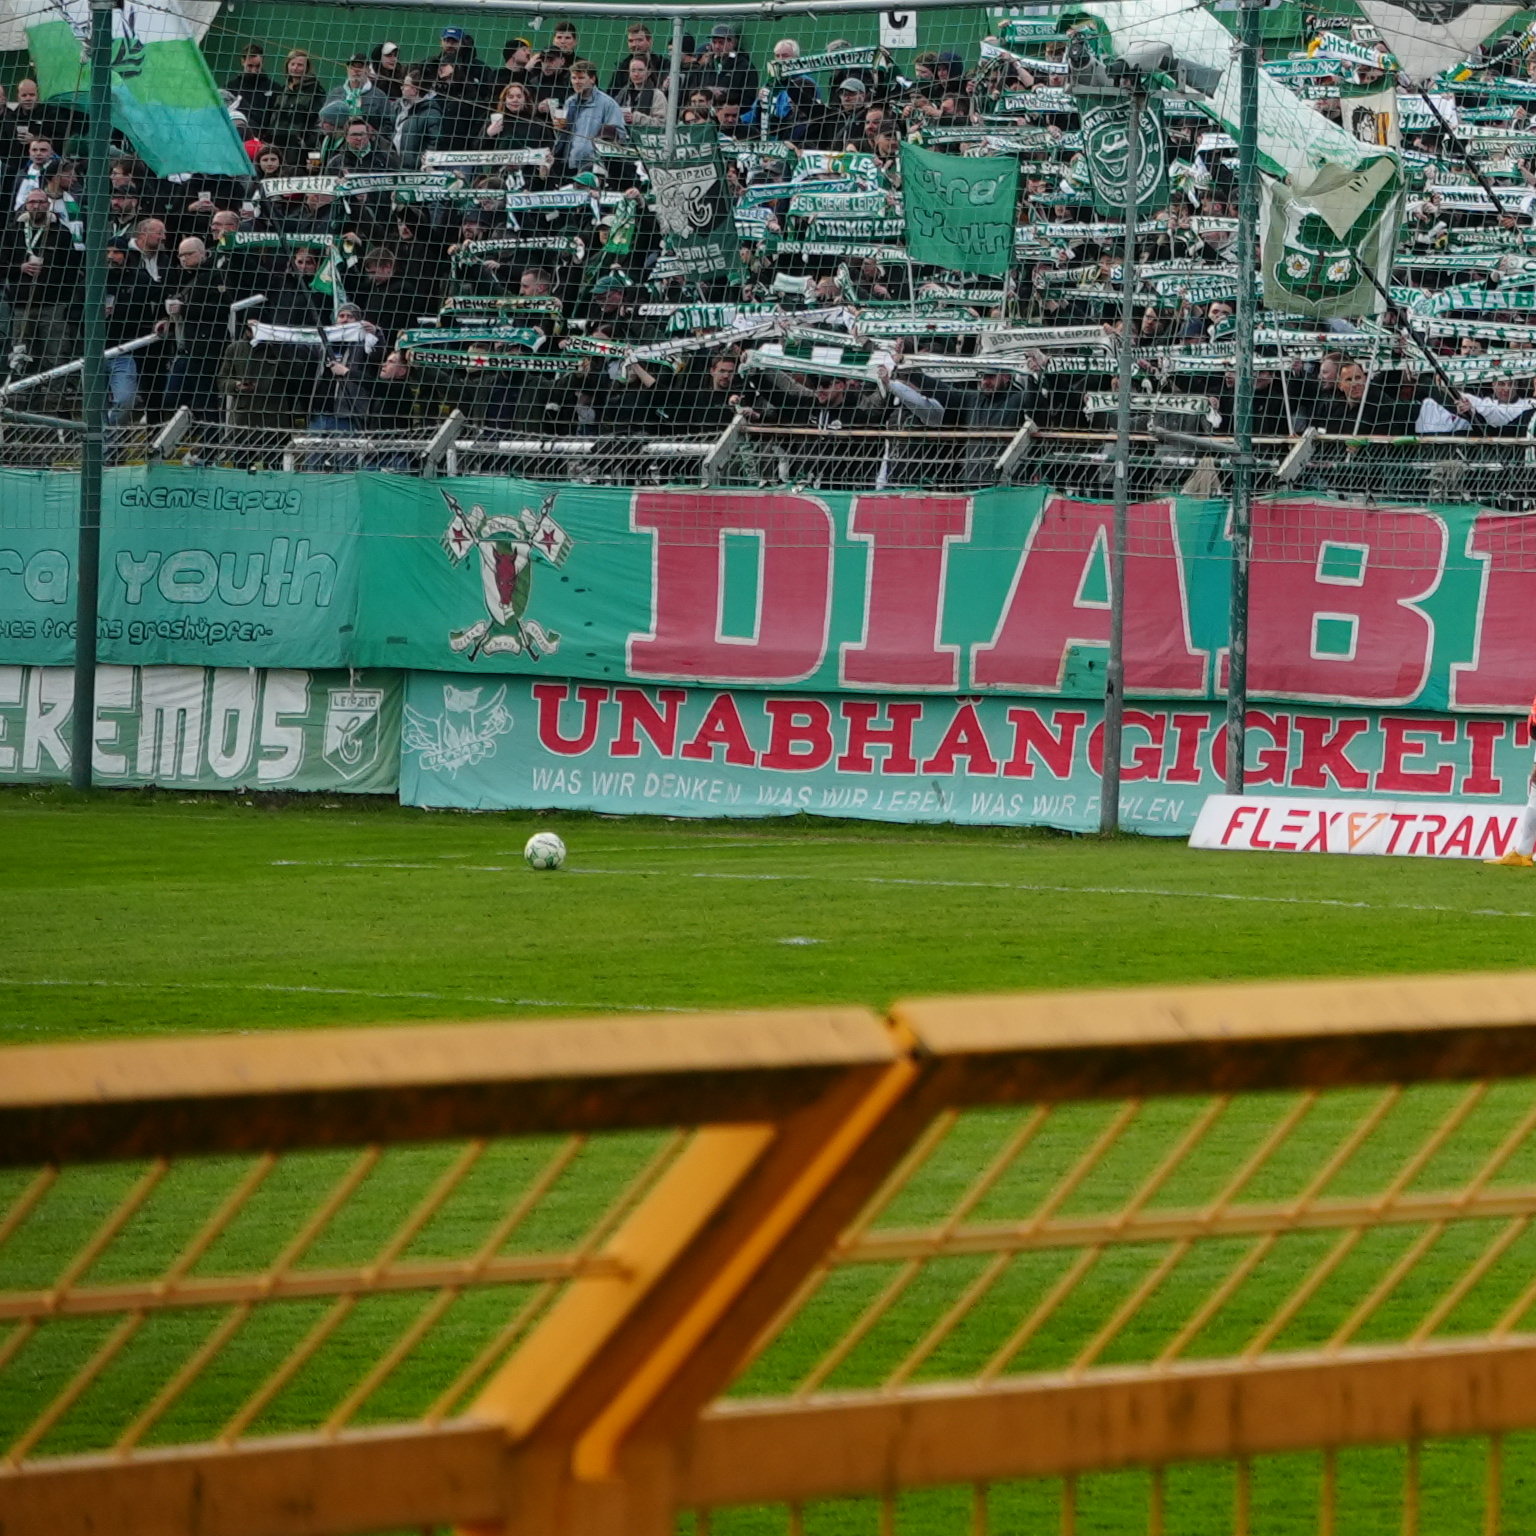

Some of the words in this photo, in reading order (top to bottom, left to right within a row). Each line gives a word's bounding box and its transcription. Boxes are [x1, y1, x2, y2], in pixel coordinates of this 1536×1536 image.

[531, 768, 582, 793] WAS
[592, 770, 635, 796] WIR
[756, 786, 808, 808] WAS
[822, 788, 866, 810] WIR
[970, 791, 1023, 818] WAS
[1032, 793, 1077, 819] WIR
[1086, 795, 1182, 823] FHLEN
[1221, 806, 1339, 850] FLEX
